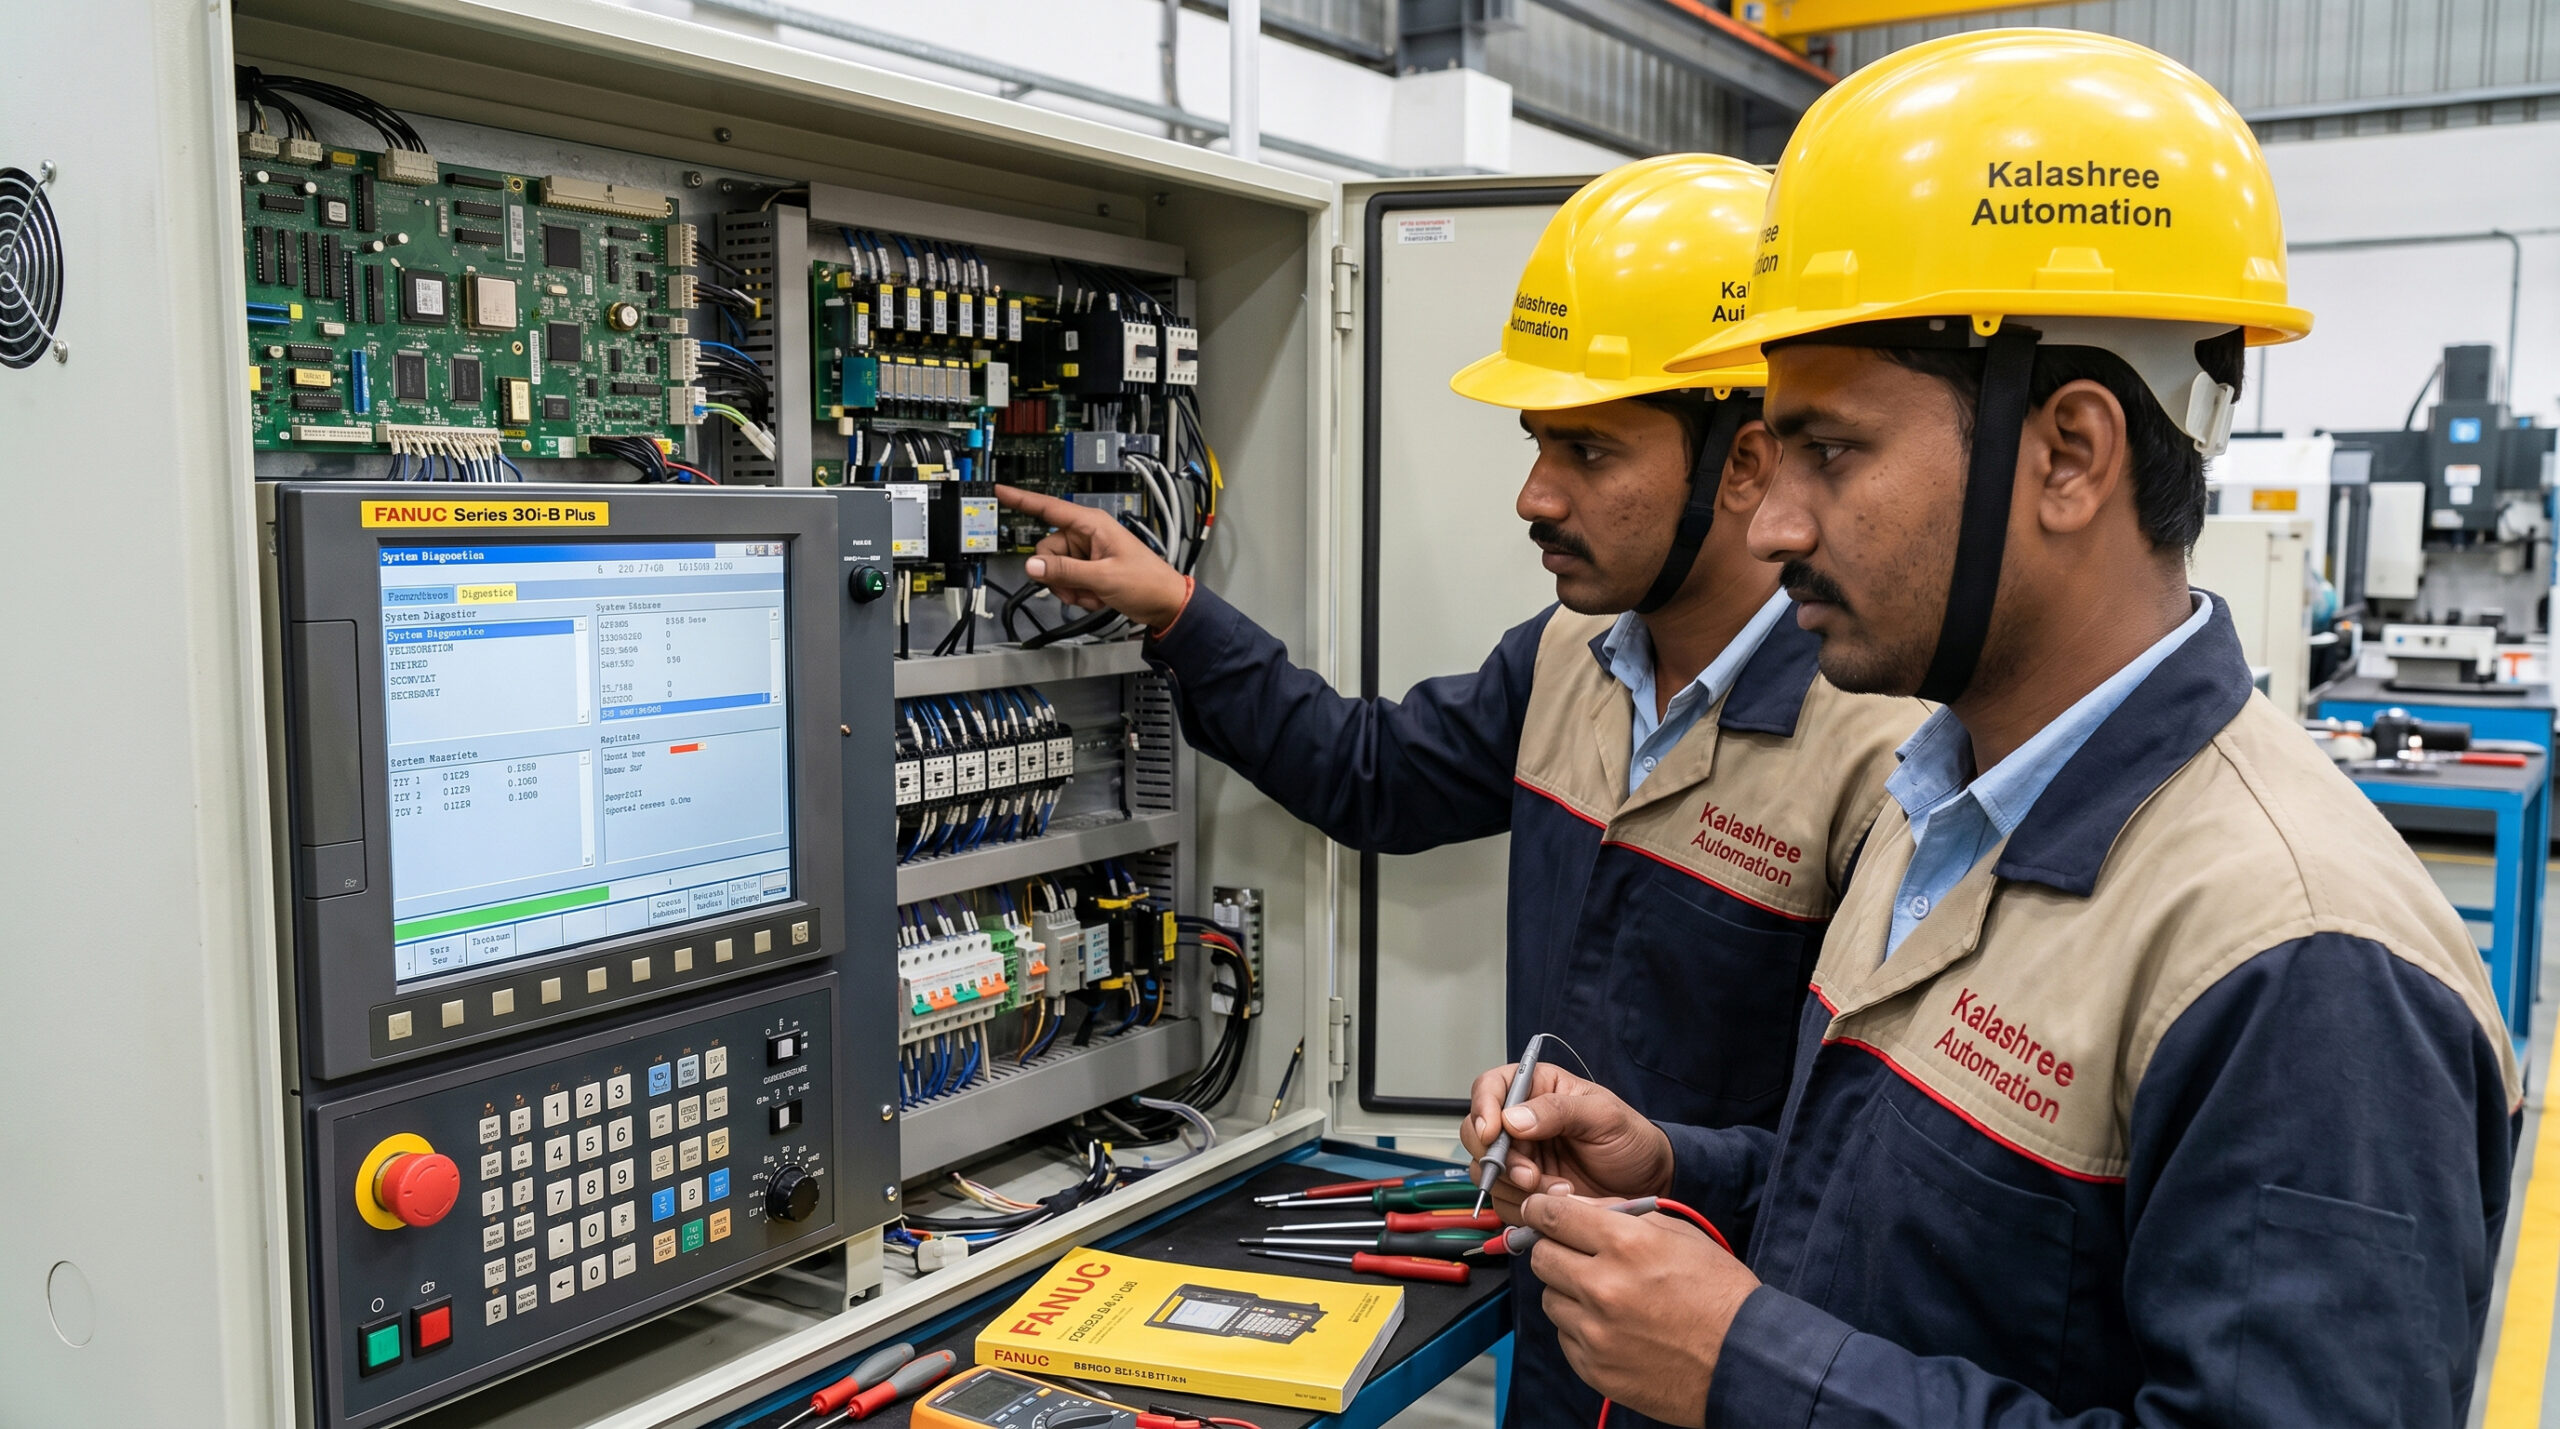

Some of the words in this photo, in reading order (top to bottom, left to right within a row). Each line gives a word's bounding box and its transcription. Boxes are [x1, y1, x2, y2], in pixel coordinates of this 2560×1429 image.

[1988, 160, 2159, 189] Kalashree
[1971, 198, 2171, 228] Automation
[374, 507, 448, 522] FANUC
[454, 507, 508, 522] Series
[513, 507, 560, 522] 30i-B
[565, 507, 596, 522] Plus
[1699, 801, 1801, 863] Kalashree
[1690, 830, 1792, 887] Automation
[1950, 988, 2074, 1087] Kalashree
[1933, 1027, 2060, 1124] Automation
[614, 1084, 624, 1099] 3
[584, 1093, 593, 1108] 2
[552, 1102, 559, 1117] 1
[616, 1127, 626, 1142] 6
[585, 1136, 595, 1151] 5
[553, 1146, 563, 1160] 4
[618, 1169, 627, 1184] 9
[587, 1180, 596, 1195] 8
[555, 1190, 564, 1205] 7
[588, 1223, 597, 1238] 0
[590, 1266, 599, 1280] 0
[1009, 1262, 1111, 1337] FANUC
[994, 1350, 1049, 1367] FANUC
